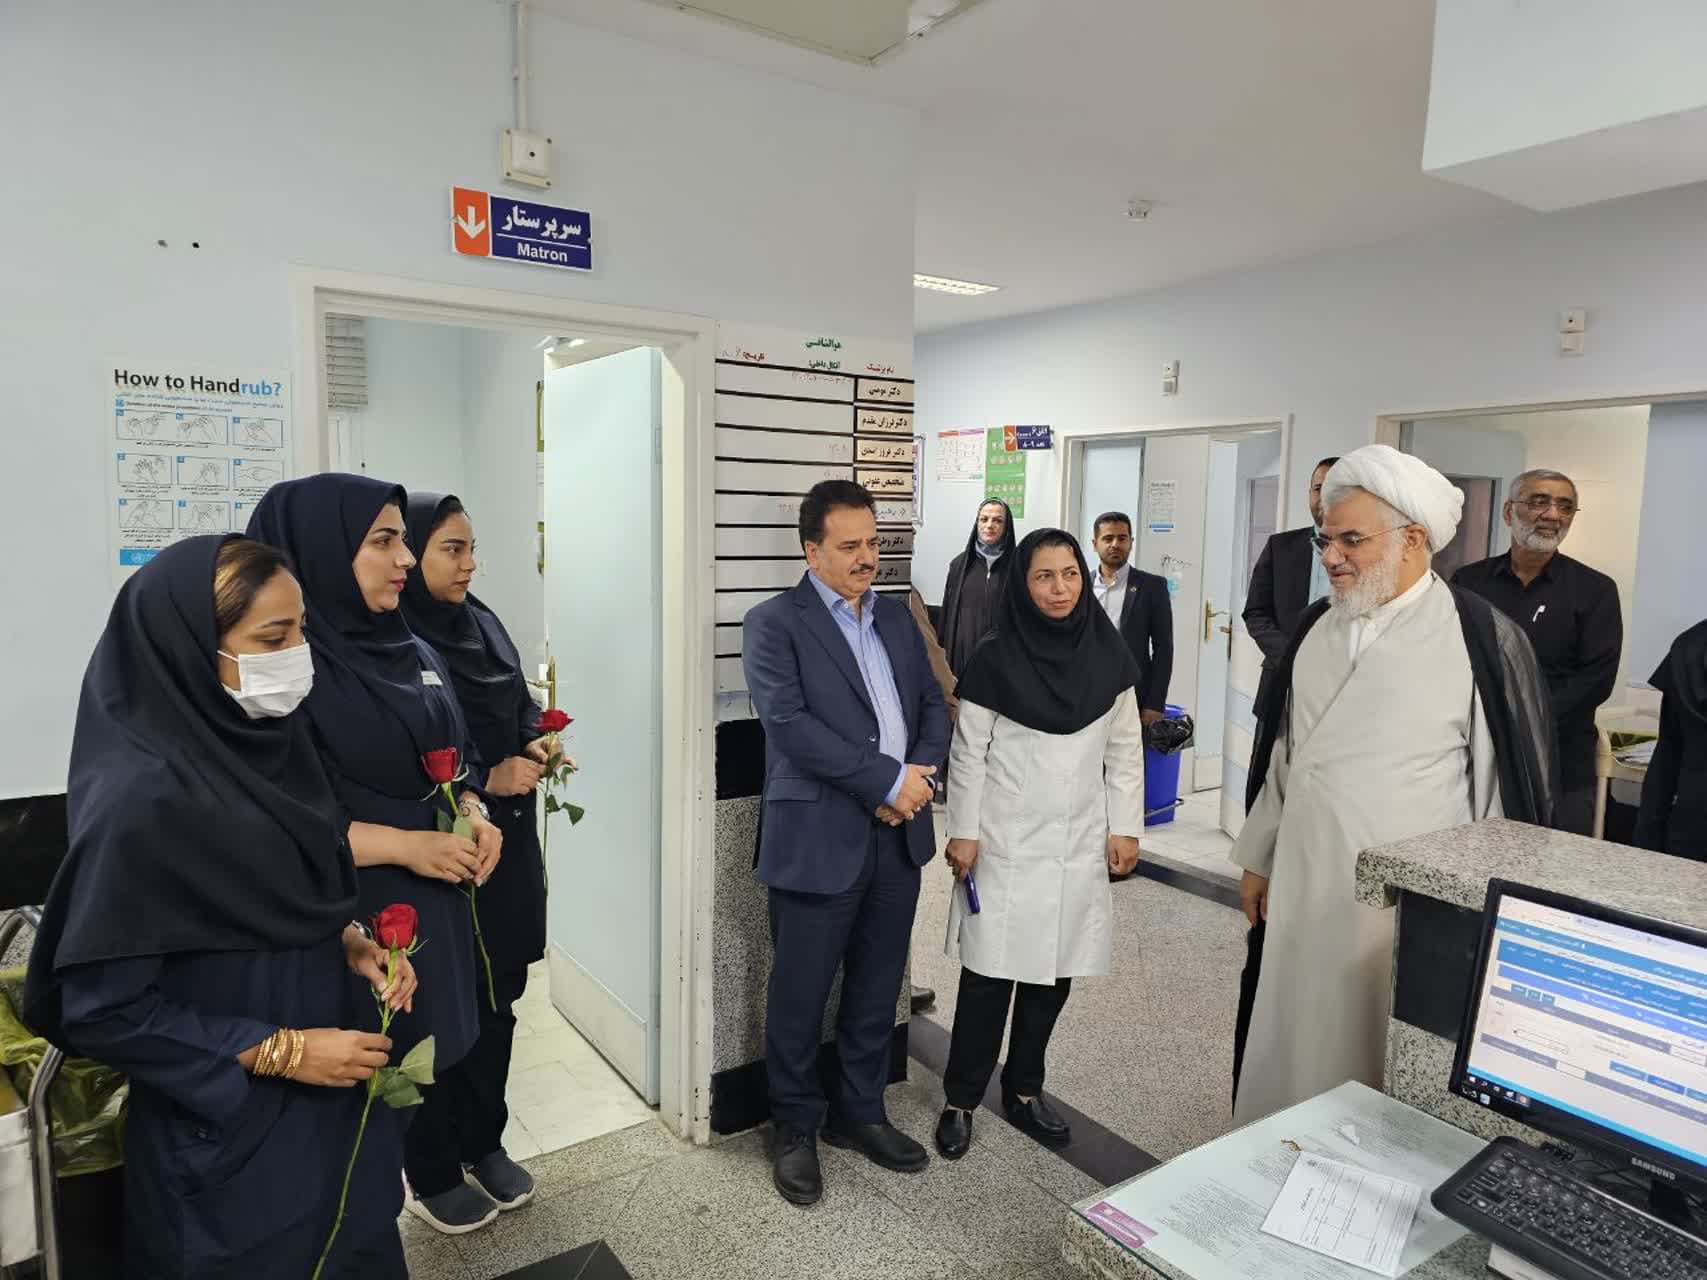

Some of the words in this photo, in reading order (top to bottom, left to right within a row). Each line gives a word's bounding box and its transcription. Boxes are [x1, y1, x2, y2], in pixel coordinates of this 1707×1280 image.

[501, 204, 581, 240] سرپرستار
[517, 242, 568, 262] Matron
[114, 368, 159, 387] How
[164, 374, 185, 390] to
[190, 375, 282, 397] Handrub?
[887, 386, 901, 398] دکتر
[893, 417, 908, 429] دکتر
[891, 447, 905, 459] دکتر
[890, 535, 904, 548] دکتر
[884, 566, 898, 580] دکتر
[1631, 1156, 1676, 1180] SAMSUNG
